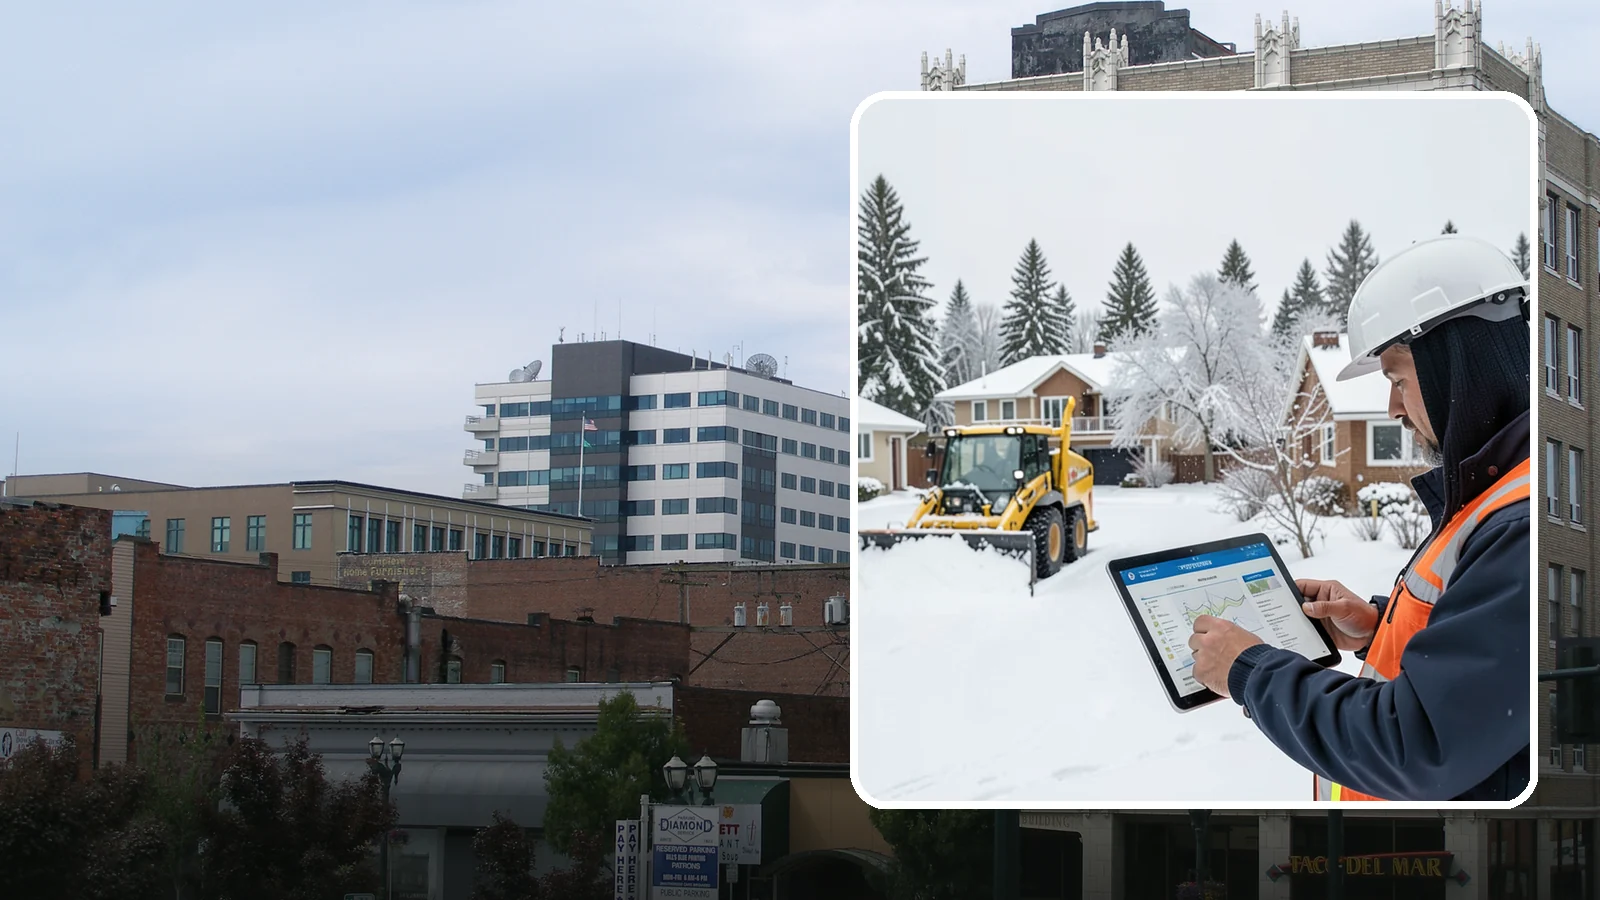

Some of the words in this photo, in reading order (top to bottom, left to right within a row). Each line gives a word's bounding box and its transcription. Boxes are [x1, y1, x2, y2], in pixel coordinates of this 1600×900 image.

[660, 818, 713, 833] DIAMOND
[1021, 815, 1070, 828] BUILDING
[617, 825, 625, 852] PAY
[628, 825, 637, 852] PAY
[656, 845, 688, 853] RESERVED
[689, 846, 716, 854] PARKING
[616, 856, 625, 894] HERE
[628, 856, 637, 893] HERE
[671, 862, 701, 870] PATRONS
[1289, 855, 1329, 874] TAC
[1346, 856, 1385, 876] DEL
[1392, 857, 1443, 877] MAR
[660, 888, 682, 897] PUBLIC
[683, 889, 710, 898] PARKING
